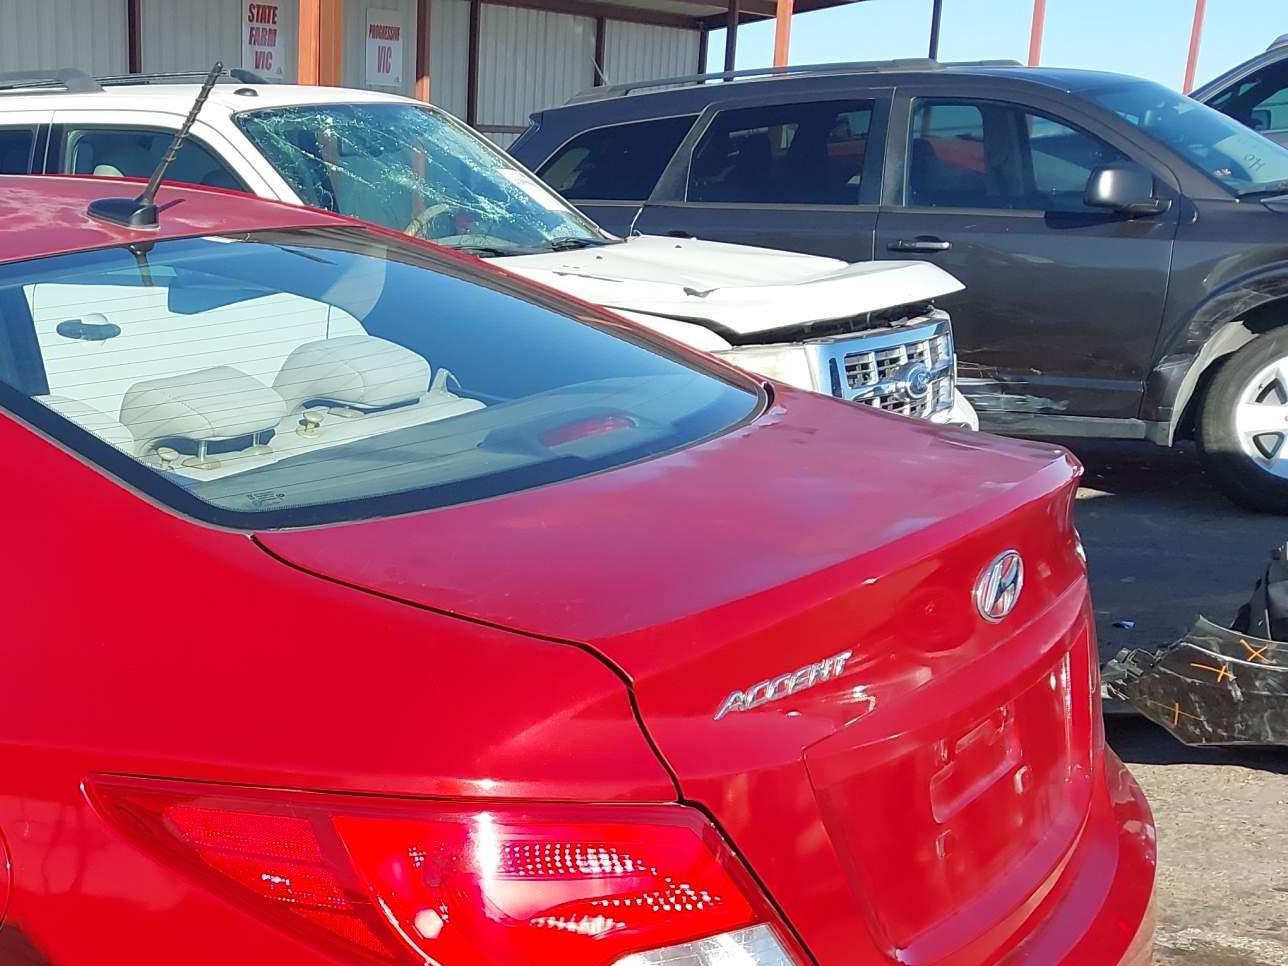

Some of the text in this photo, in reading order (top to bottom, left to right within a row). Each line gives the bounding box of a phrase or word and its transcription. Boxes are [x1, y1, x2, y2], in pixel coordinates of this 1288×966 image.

[247, 3, 278, 25] STATE
[248, 26, 278, 48] FARM
[369, 24, 400, 41] PROGRESSIVE
[254, 50, 273, 71] VIC
[377, 46, 392, 73] VIC
[713, 649, 853, 721] ACCENT
